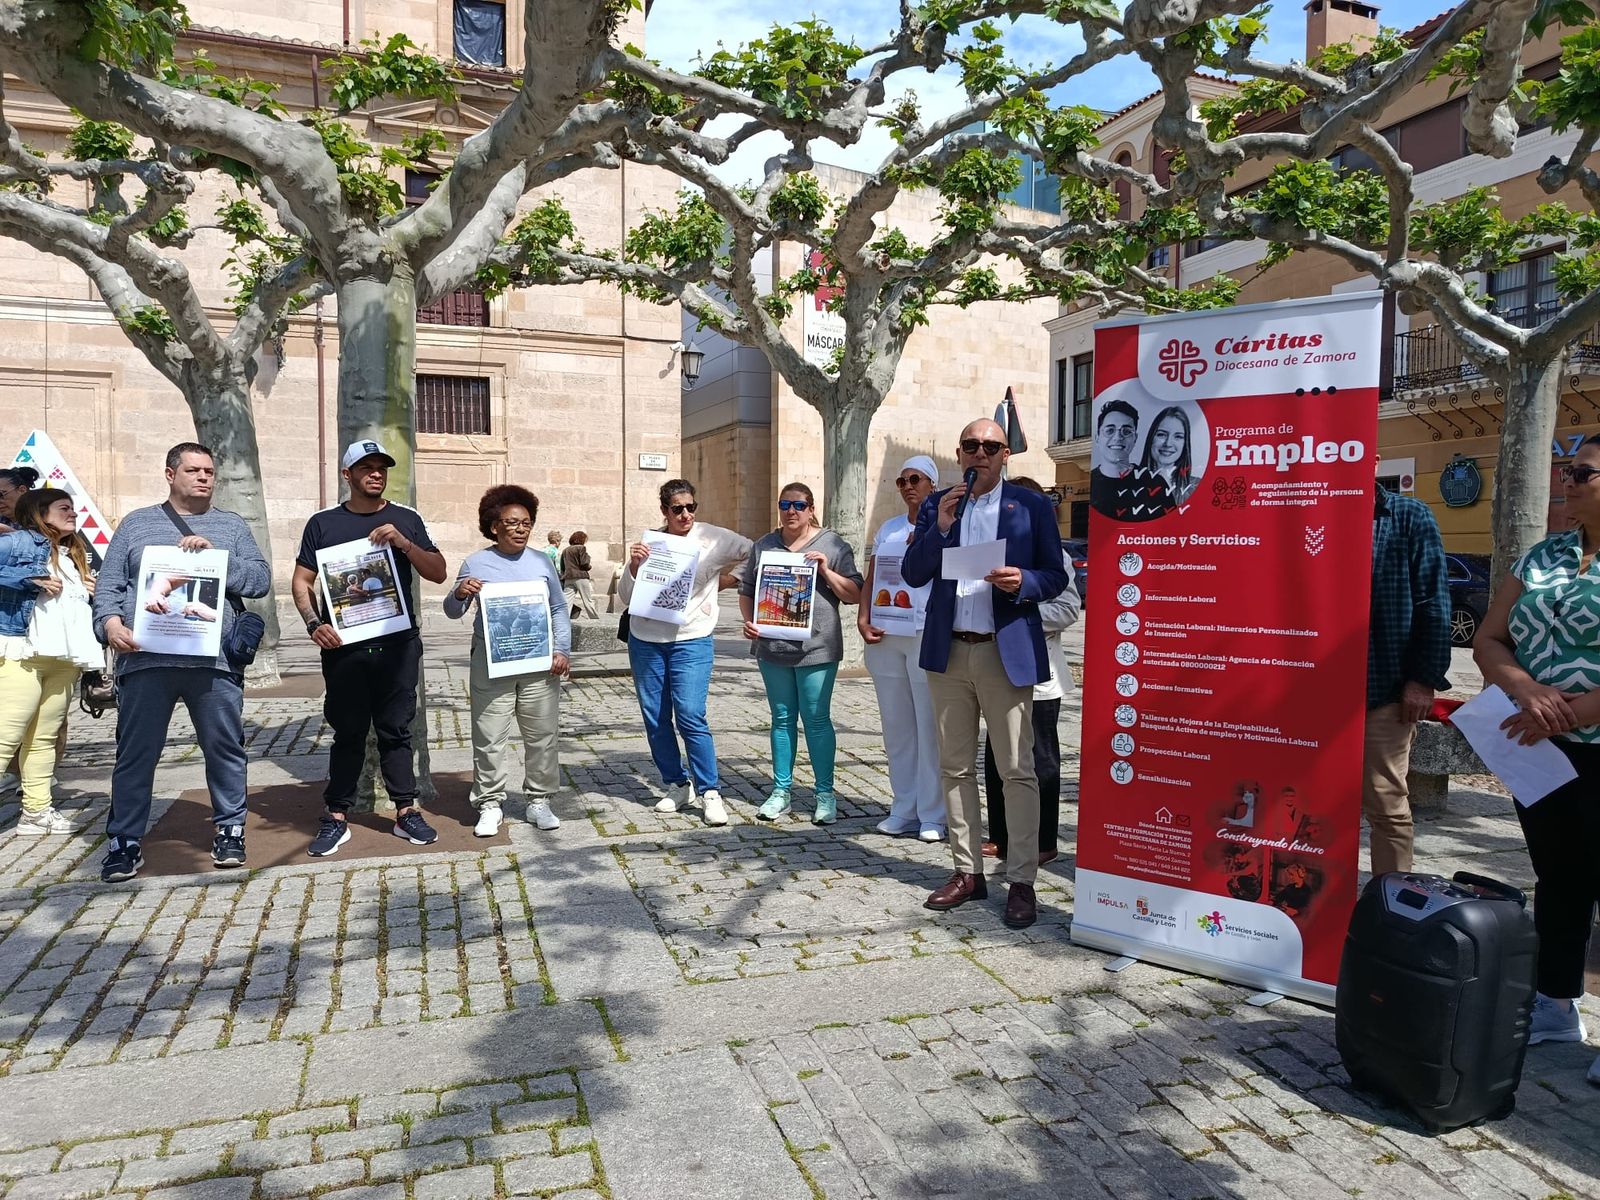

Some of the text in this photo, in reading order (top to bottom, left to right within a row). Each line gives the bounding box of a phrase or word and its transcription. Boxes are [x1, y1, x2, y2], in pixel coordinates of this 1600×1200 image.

[1215, 333, 1323, 355] Cáritas
[1215, 351, 1356, 371] Diocesana de Zamora
[1215, 423, 1294, 438] Programa de
[1215, 435, 1365, 472] Empleo
[1251, 481, 1321, 490] Acompañamiento
[1258, 488, 1364, 498] seguimiento de la persona
[1261, 498, 1285, 506] forma
[1286, 498, 1318, 507] integral
[1117, 533, 1260, 548] Acciones y Servicios:
[1147, 563, 1217, 571] Acogida/Motivación
[1145, 594, 1217, 603] Información Laboral
[1144, 621, 1319, 637] Orientación Laboral: Itinerarios Personalizados
[1154, 630, 1187, 638] Inserción
[1143, 650, 1197, 660] Intermediación
[1197, 653, 1228, 662] Laboral:
[1229, 655, 1259, 664] Agencia
[1271, 658, 1315, 668] Colocación
[1143, 659, 1180, 667] autorizada
[1142, 682, 1213, 695] Acciones formativas
[1141, 713, 1168, 722] Talleres
[1179, 717, 1203, 726] Mejora
[1223, 722, 1281, 734] Empleabilidad,
[1140, 721, 1174, 731] Búsqueda
[1175, 725, 1198, 734] Activa
[1209, 730, 1237, 738] empleo
[1244, 732, 1288, 744] Motivación
[1288, 737, 1319, 748] Laboral
[1140, 745, 1211, 760] Prospección Laboral
[1138, 773, 1191, 787] Sensibilización
[1103, 823, 1124, 831] CENTRO
[1133, 828, 1164, 838] FORMACIÓN
[1170, 834, 1192, 843] EMPLEO
[1216, 828, 1325, 855] Construyendo futuro
[1132, 913, 1154, 924] Castilla
[1160, 920, 1177, 928] León
[1149, 911, 1167, 920] Junta
[1225, 924, 1279, 941] Servicios Sociales
